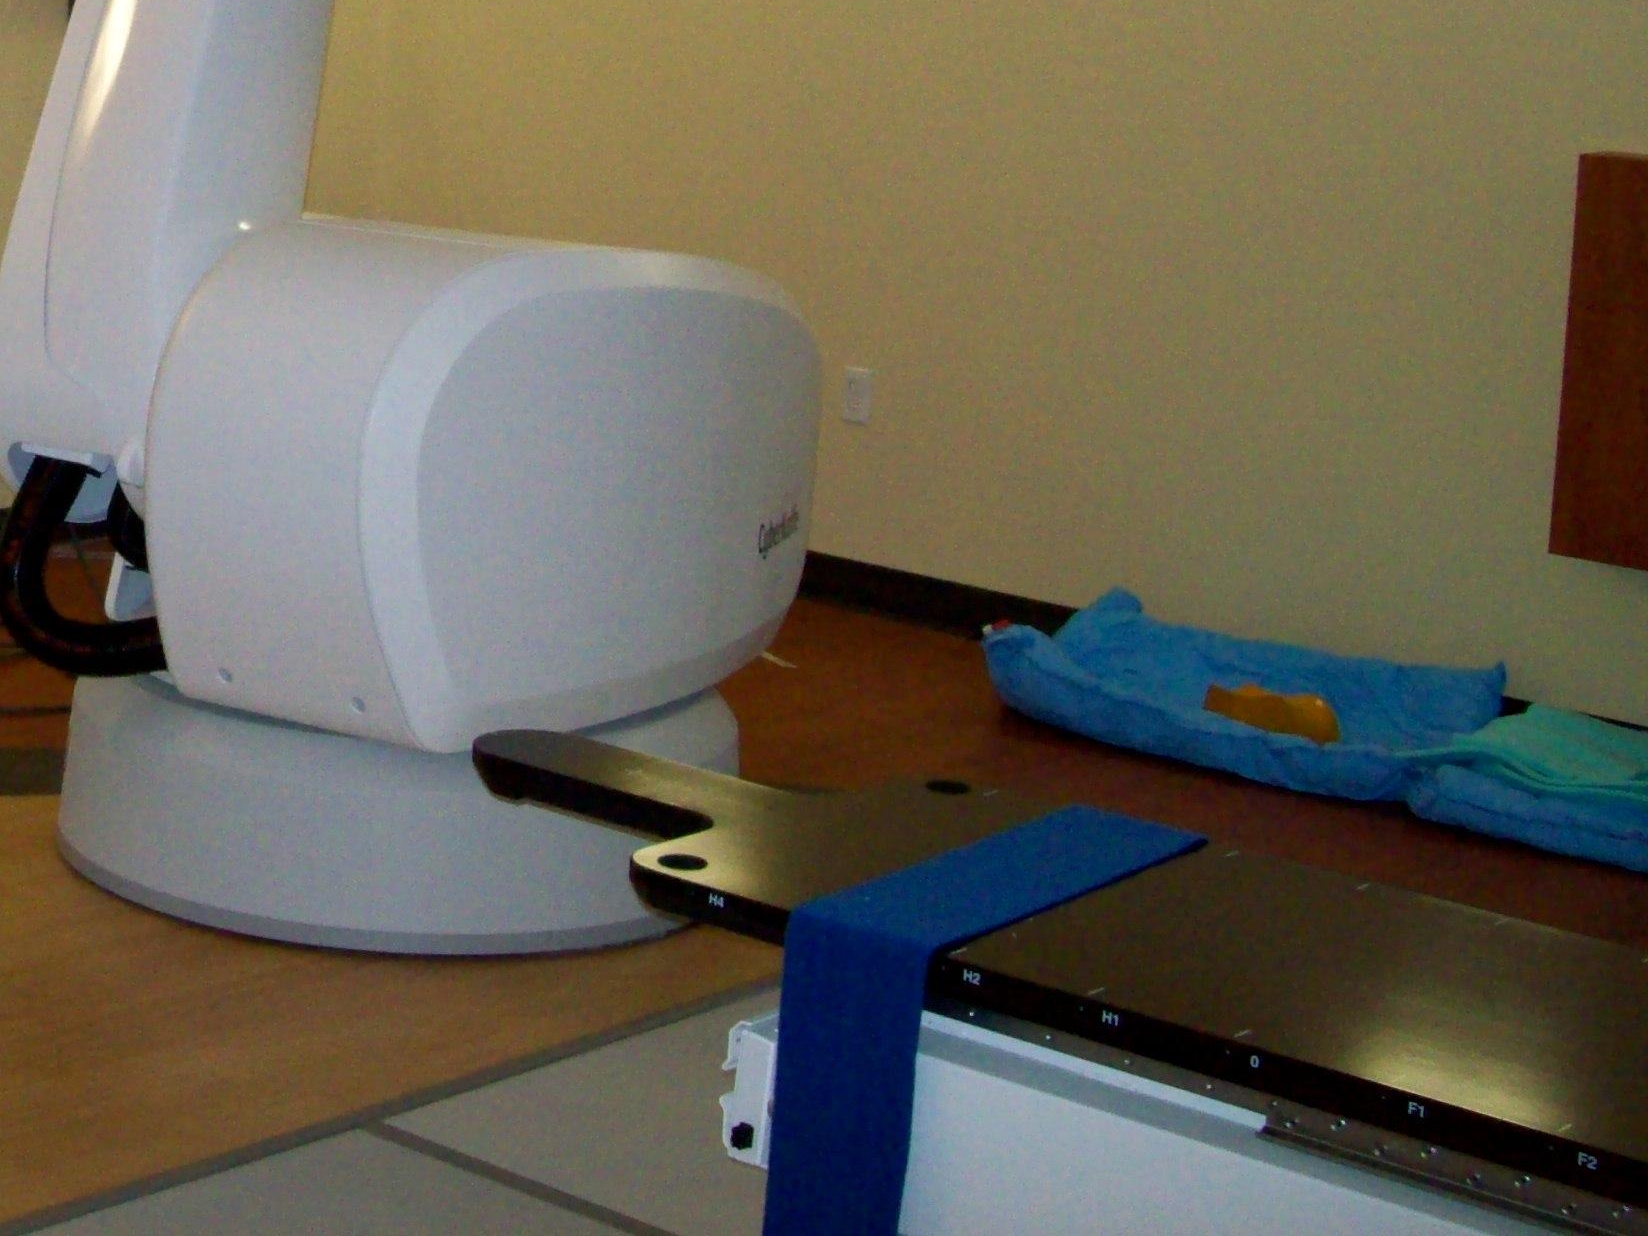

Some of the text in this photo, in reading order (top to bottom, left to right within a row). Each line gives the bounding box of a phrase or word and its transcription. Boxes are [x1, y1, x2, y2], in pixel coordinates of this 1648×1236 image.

[708, 892, 724, 908] H4
[963, 968, 982, 985] H2
[1102, 1010, 1119, 1026] H1
[1407, 1101, 1425, 1118] F1
[1578, 1151, 1598, 1170] F2
